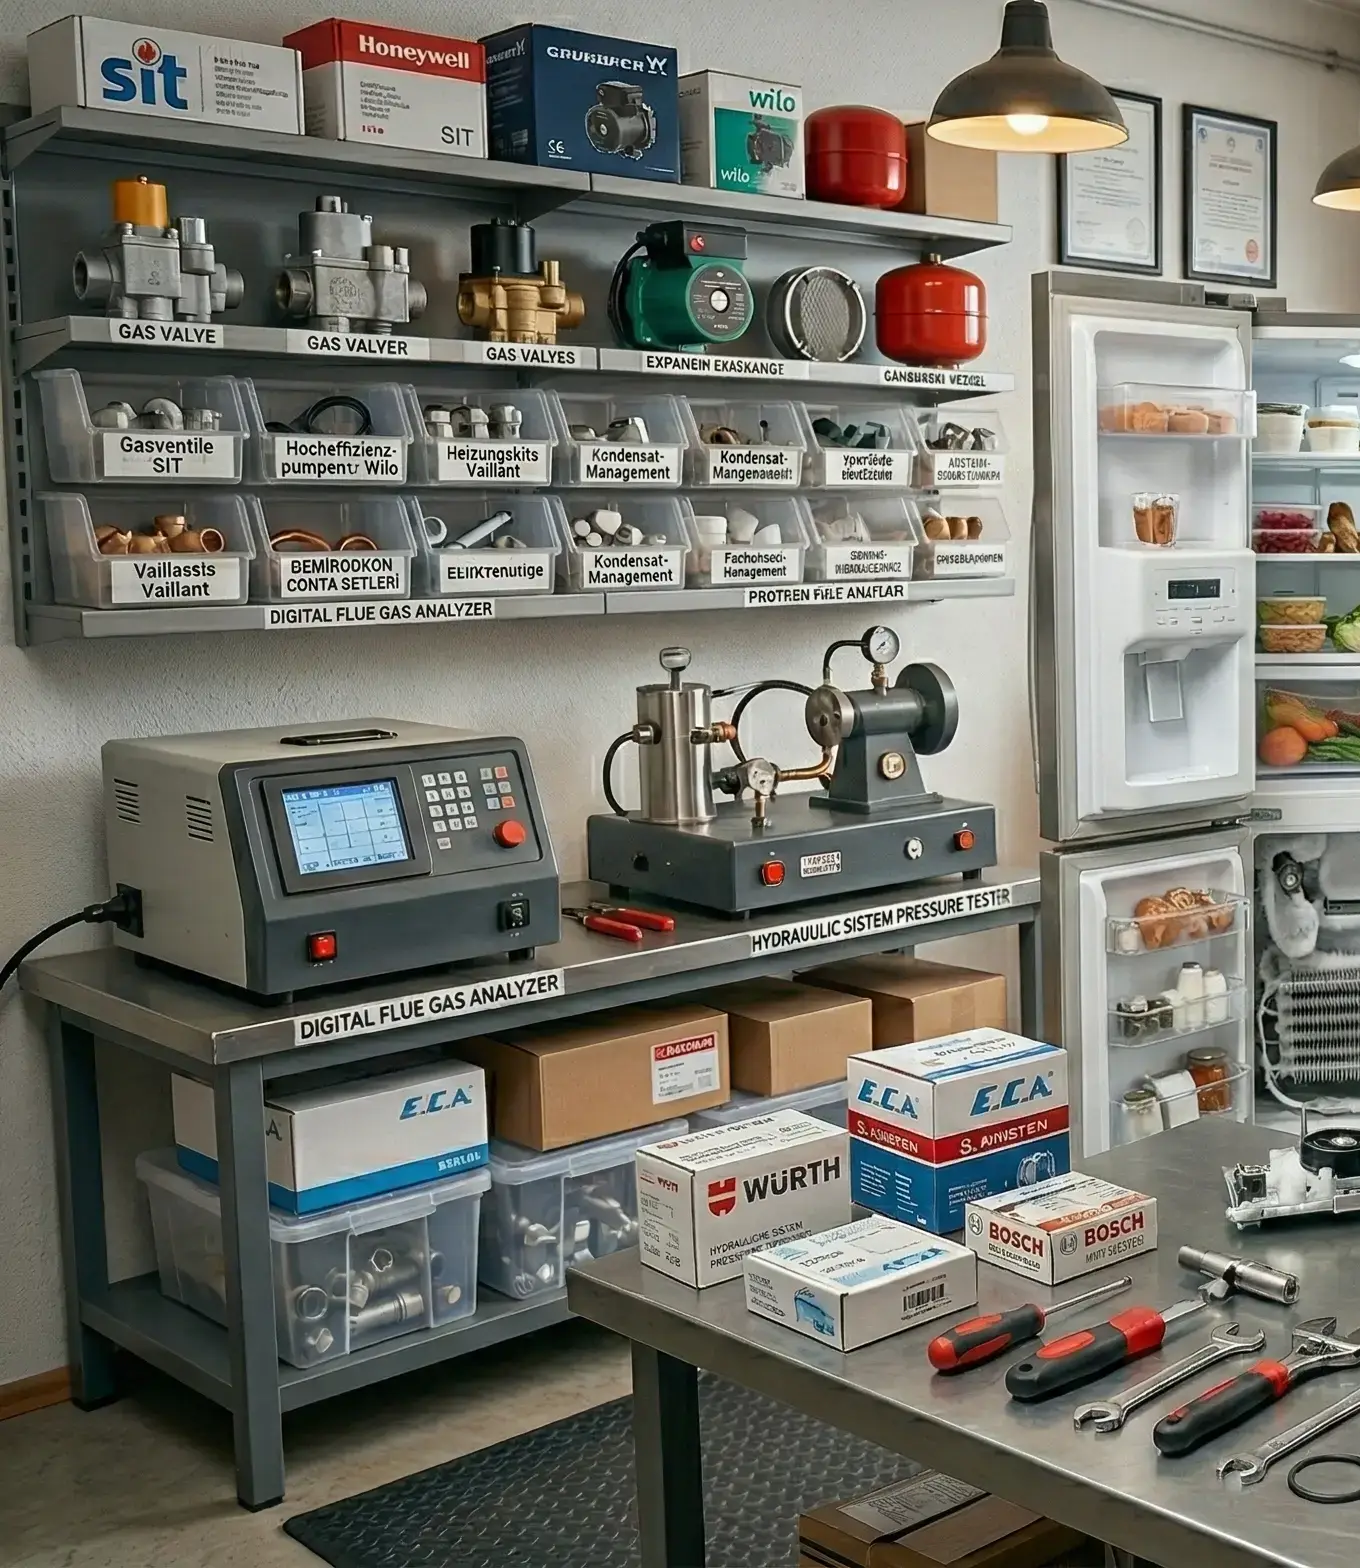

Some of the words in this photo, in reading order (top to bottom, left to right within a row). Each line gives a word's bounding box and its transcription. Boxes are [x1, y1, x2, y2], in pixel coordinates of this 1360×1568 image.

[359, 34, 470, 69] Honeywell
[749, 88, 796, 112] wilo
[441, 125, 474, 147] SIT
[720, 167, 750, 183] wilo
[118, 323, 156, 341] GAS
[307, 335, 341, 351] GAS
[486, 347, 517, 362] GAS
[120, 436, 214, 454] Gasventile
[286, 440, 397, 458] Hocheffizienz-
[447, 445, 539, 465] Heizungskits
[720, 450, 788, 465] Kondensat-
[152, 457, 183, 473] SIT
[364, 460, 399, 475] Wilo
[466, 463, 521, 478] Vaillant
[586, 464, 670, 482] Management
[594, 554, 669, 569] Kondensat-
[287, 577, 338, 592] CONTA
[341, 573, 399, 590] SETLERİ
[588, 569, 673, 586] Management
[142, 581, 210, 598] Vaillant
[270, 607, 332, 625] DIGITAL
[336, 606, 375, 621] FLUE
[379, 605, 412, 620] GAS
[415, 602, 493, 619] ANALYZER
[752, 920, 841, 952] HYDRAUULIC
[843, 909, 894, 935] SISTEM
[896, 897, 965, 928] PRESSURE
[300, 1011, 375, 1040] DIGITAL
[380, 1004, 425, 1025] FLUE
[428, 993, 466, 1015] GAS
[469, 974, 559, 1007] ANALYZER
[1084, 1211, 1144, 1247] BOSCH
[989, 1221, 1044, 1258] BOSCH
